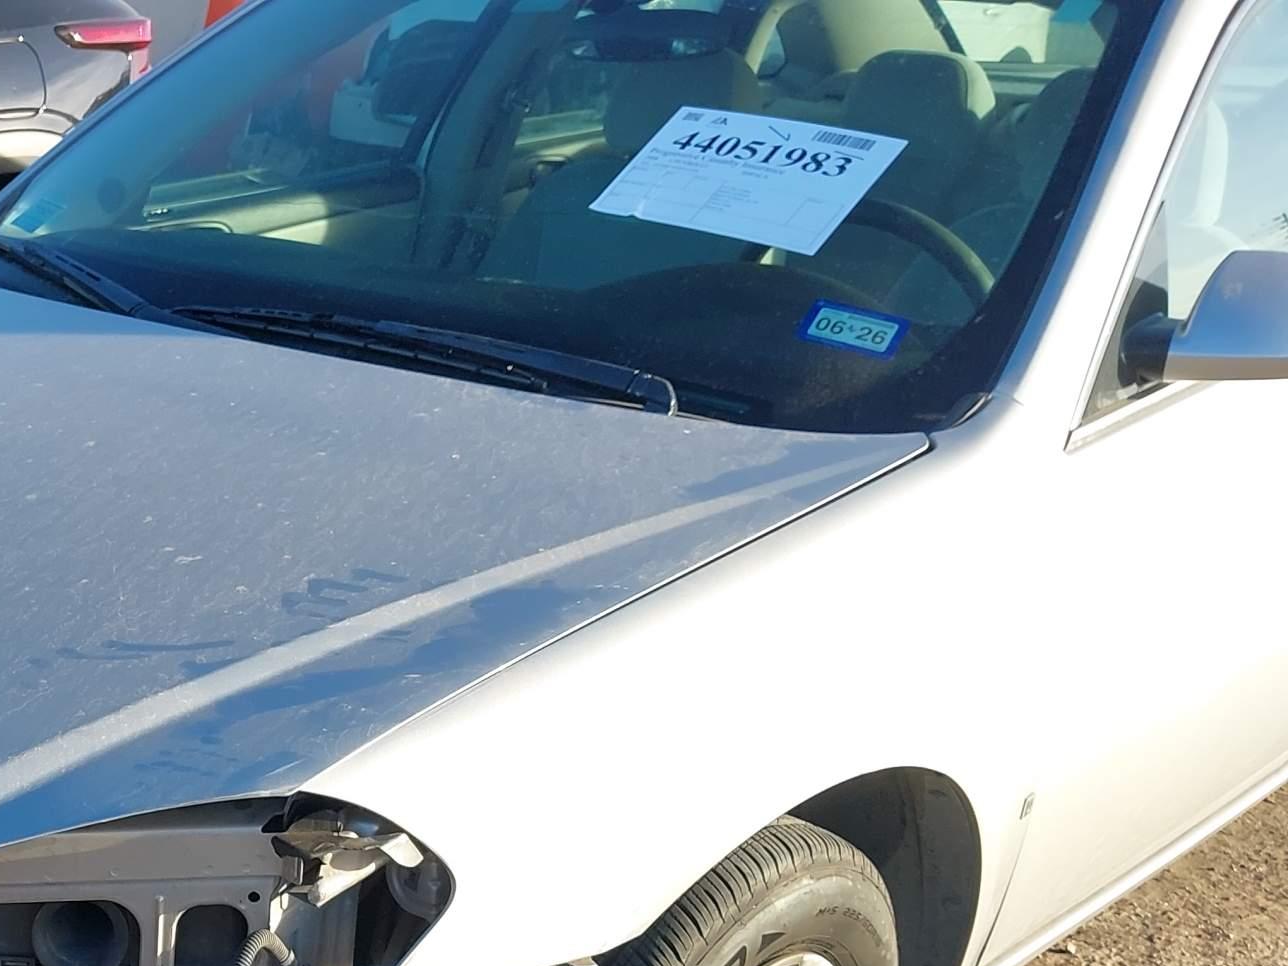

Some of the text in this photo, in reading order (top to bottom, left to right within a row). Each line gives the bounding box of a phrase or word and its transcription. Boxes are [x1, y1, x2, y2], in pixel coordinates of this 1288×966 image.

[673, 130, 853, 178] 44051983
[815, 316, 847, 335] 06
[854, 326, 889, 345] 26
